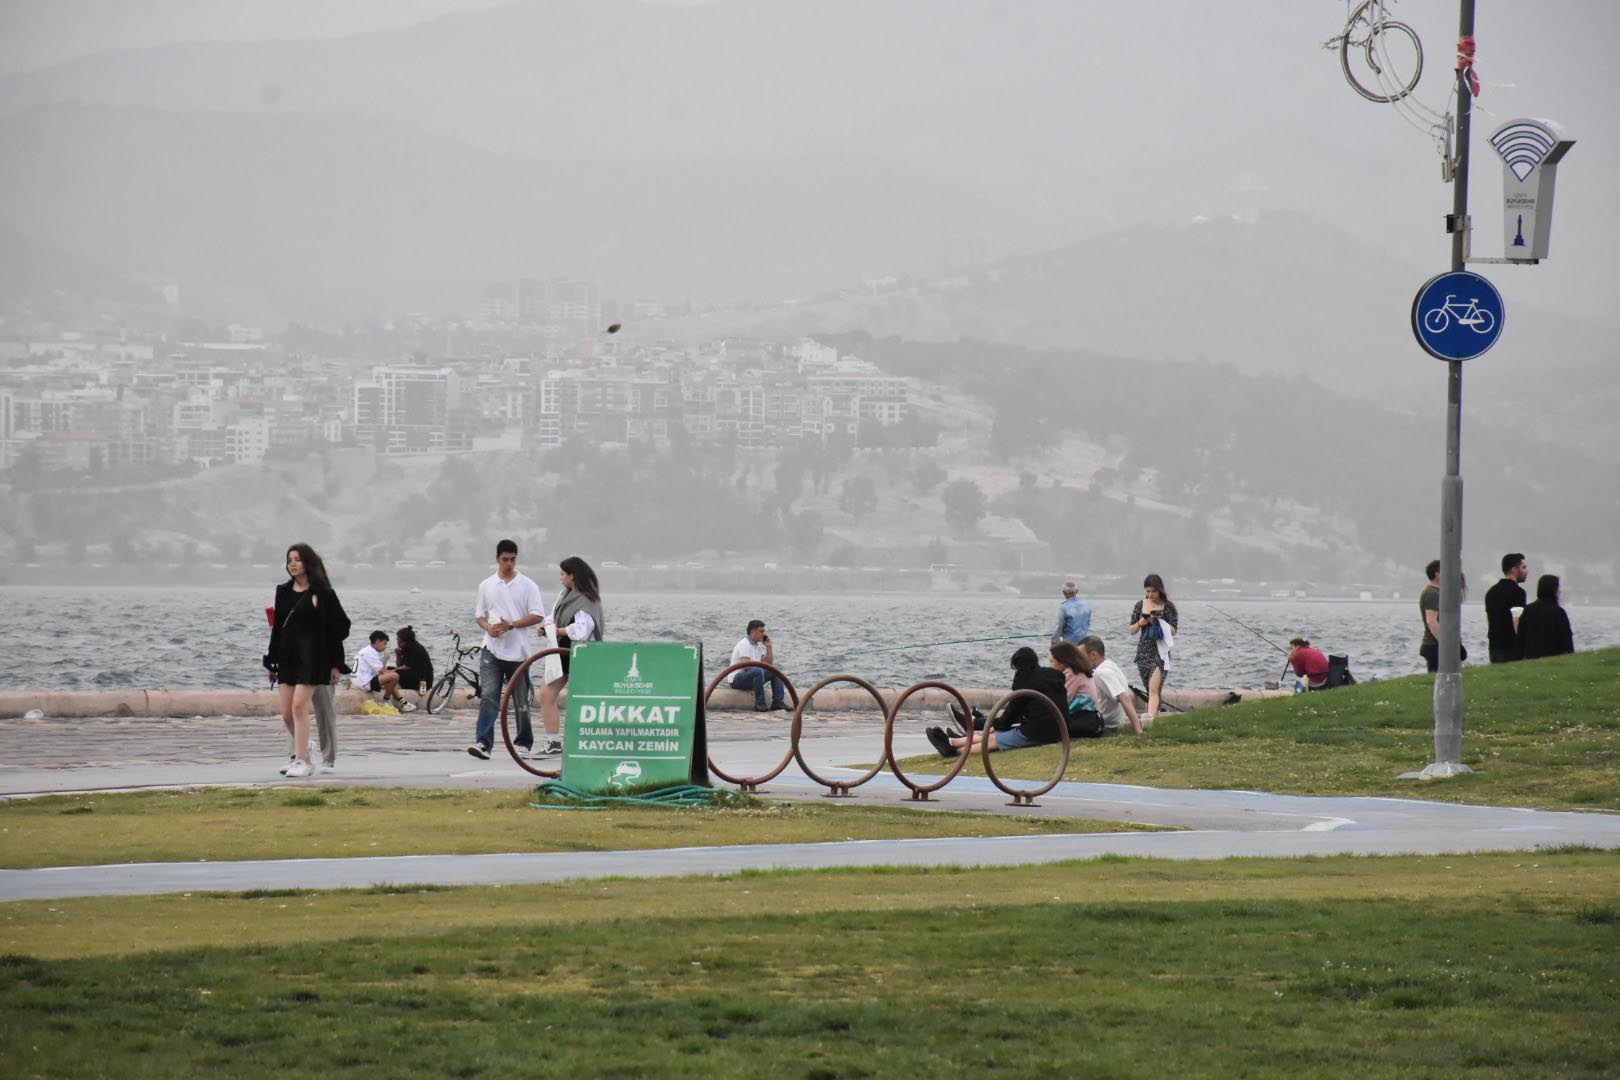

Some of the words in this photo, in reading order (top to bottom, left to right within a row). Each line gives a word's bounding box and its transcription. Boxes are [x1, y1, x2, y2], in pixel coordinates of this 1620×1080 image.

[579, 701, 681, 724] DİKKAT
[579, 727, 614, 736] SULAMA
[616, 727, 680, 737] YAPILMAKTADIR
[578, 740, 634, 751] KAYCAN
[637, 739, 679, 752] ZEMİN
